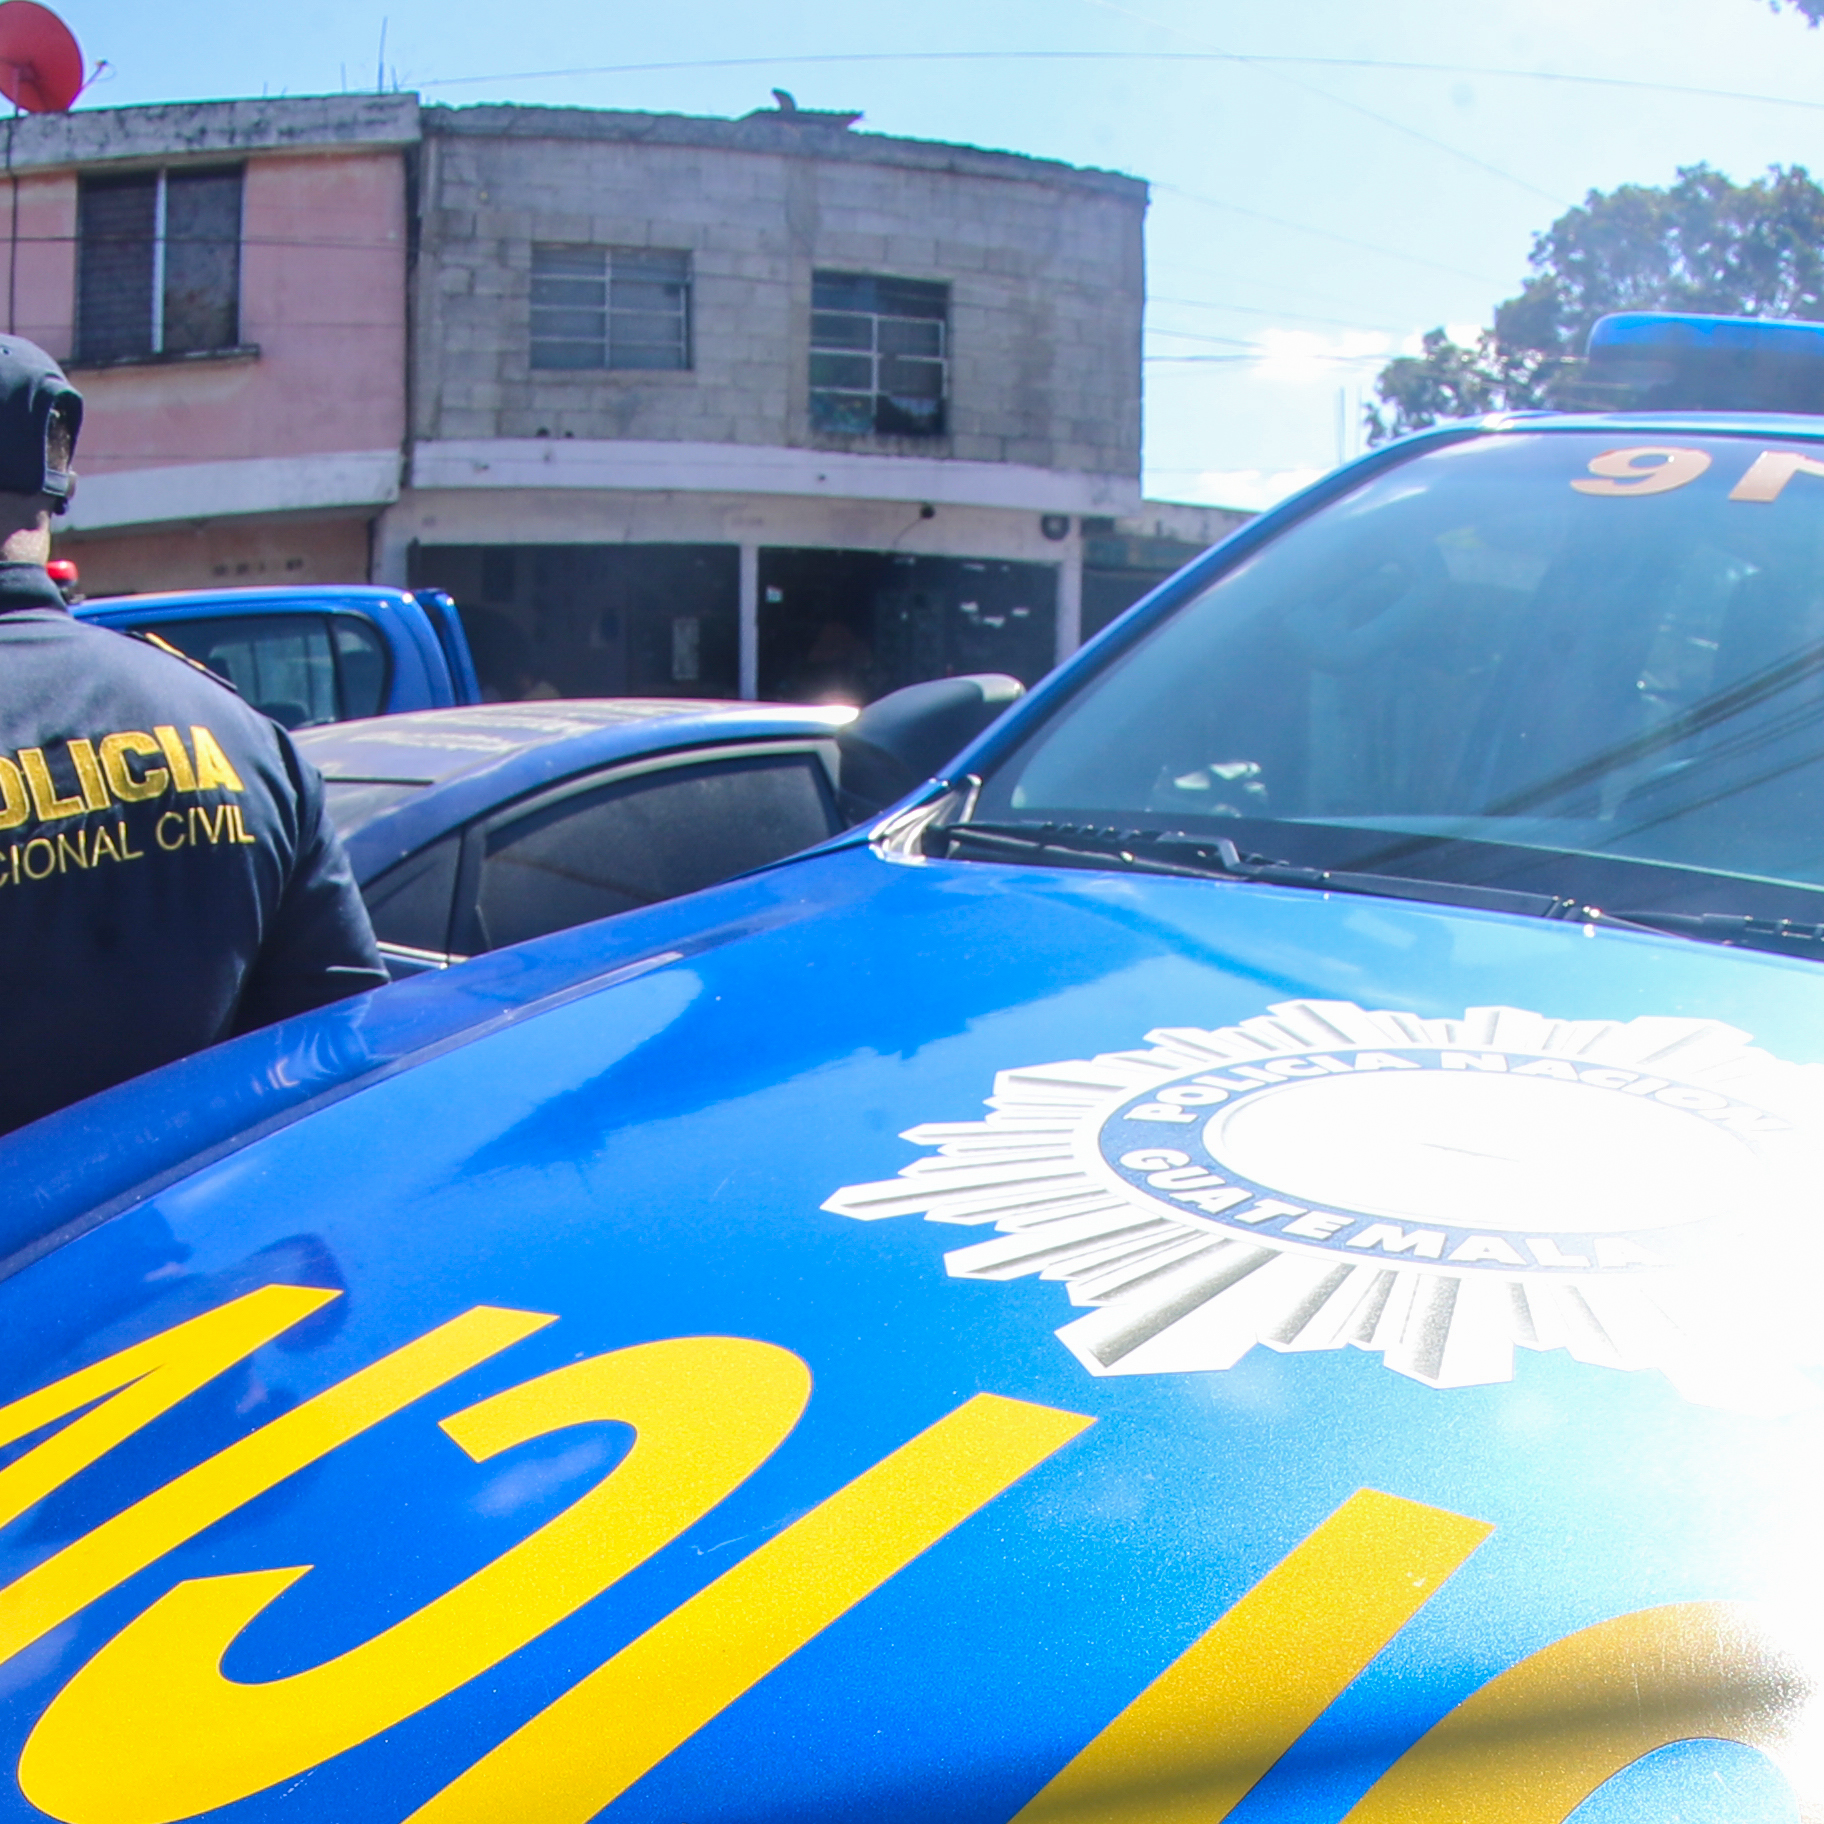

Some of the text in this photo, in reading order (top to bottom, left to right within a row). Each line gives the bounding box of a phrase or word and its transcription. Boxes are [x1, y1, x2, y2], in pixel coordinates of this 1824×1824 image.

[155, 805, 256, 850] CIVIL
[1122, 1051, 1796, 1132] POLICIA NACION
[1119, 1148, 1678, 1270] GUATEMALA
